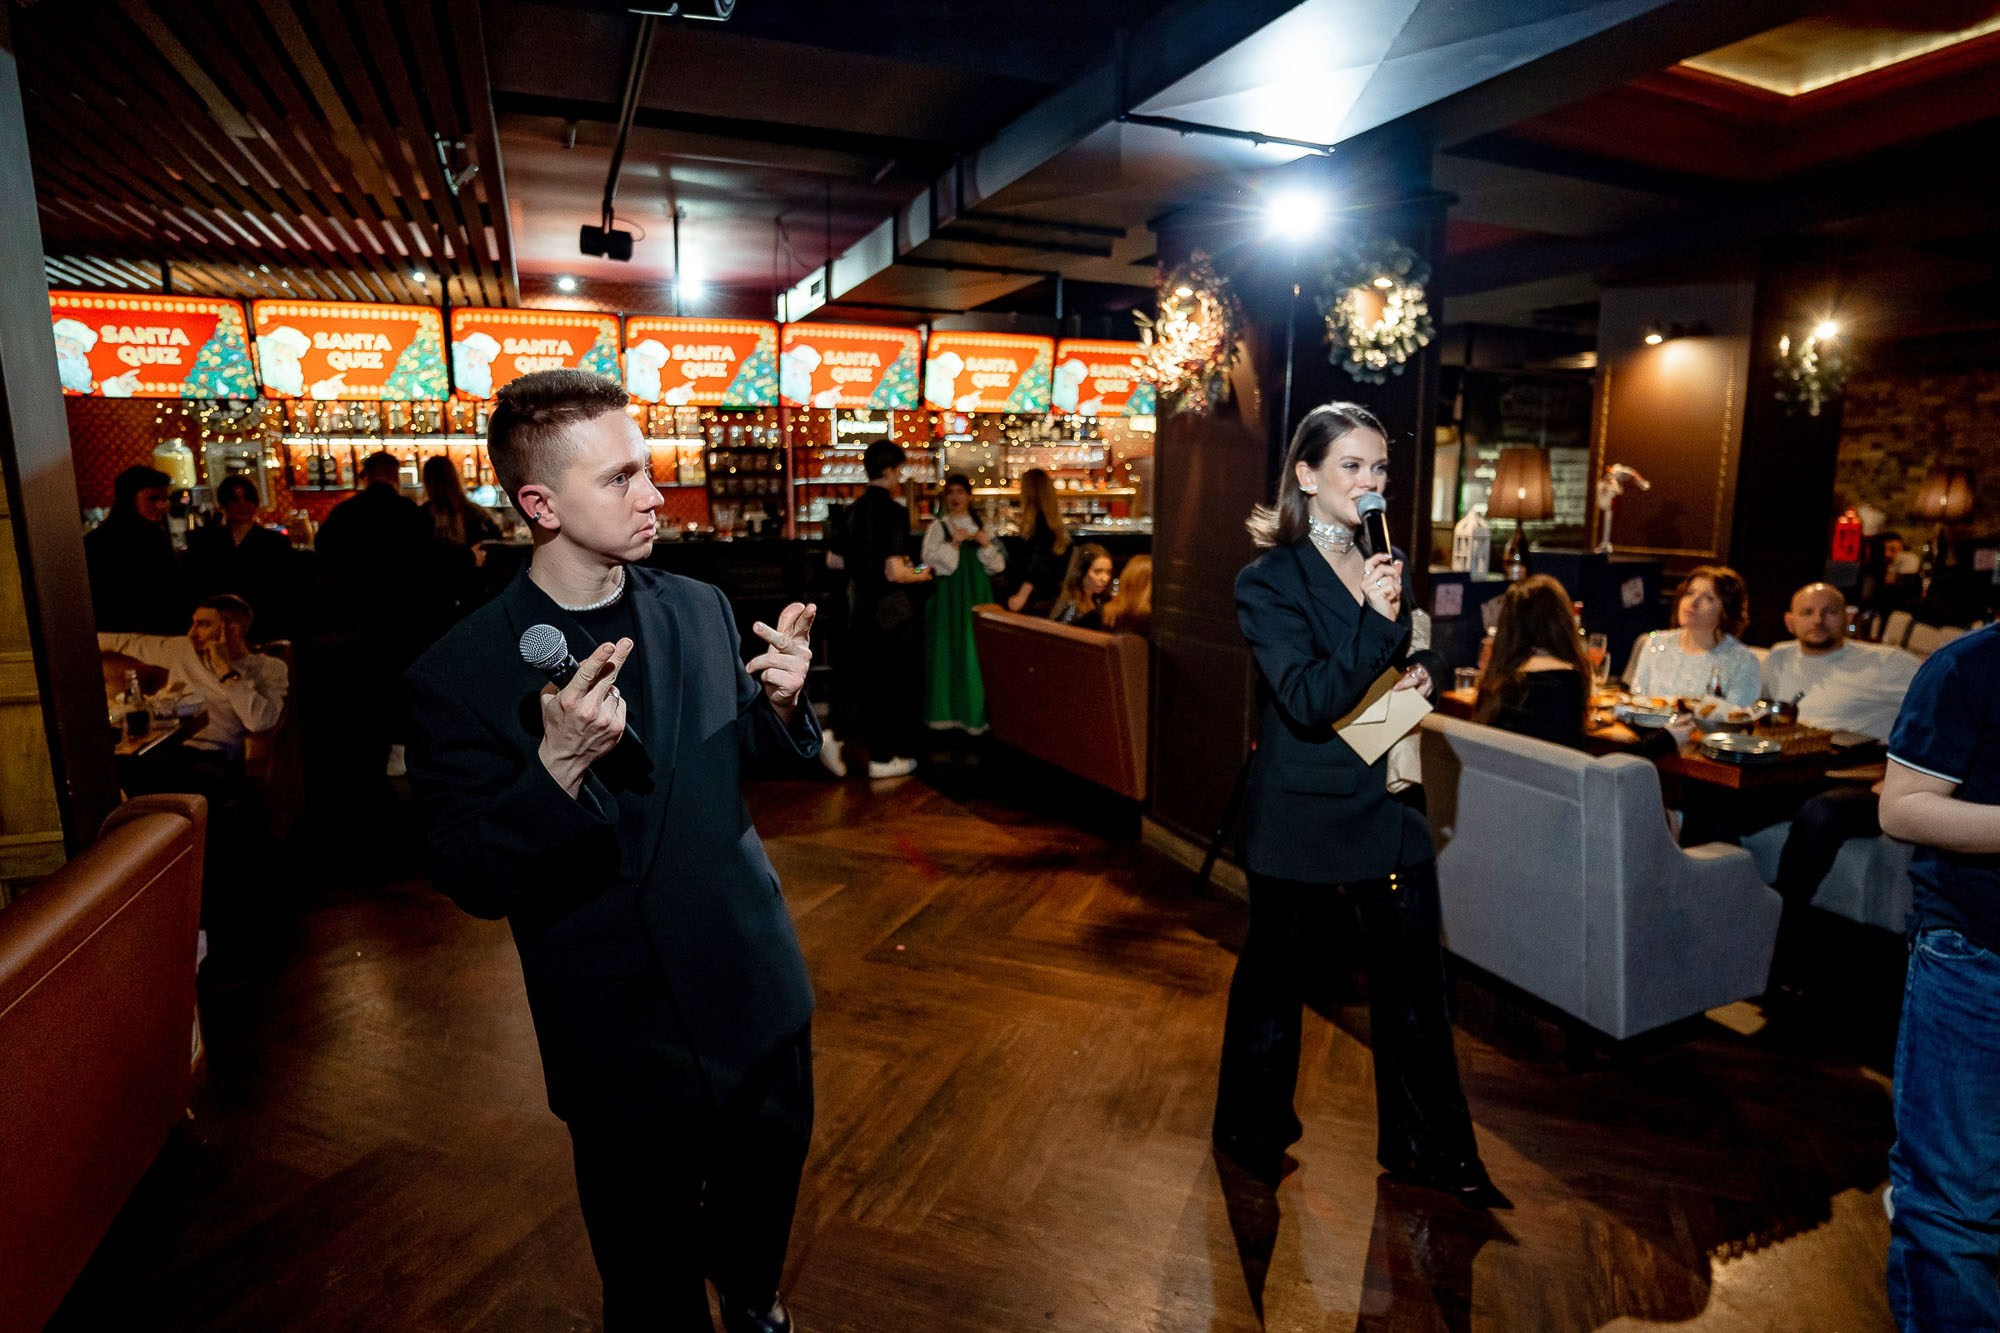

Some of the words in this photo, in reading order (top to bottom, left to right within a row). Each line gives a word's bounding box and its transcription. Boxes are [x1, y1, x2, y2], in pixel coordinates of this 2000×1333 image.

[100, 325, 190, 346] SANTA
[313, 332, 392, 351] SANTA
[503, 338, 574, 356] SANTA
[672, 344, 736, 362] SANTA
[117, 346, 182, 367] QUIZ
[327, 351, 384, 371] QUIZ
[514, 356, 565, 373] QUIZ
[822, 350, 881, 367] SANTA
[965, 357, 1018, 373] SANTA
[681, 362, 728, 379] QUIZ
[830, 367, 873, 384] QUIZ
[971, 372, 1010, 389] QUIZ
